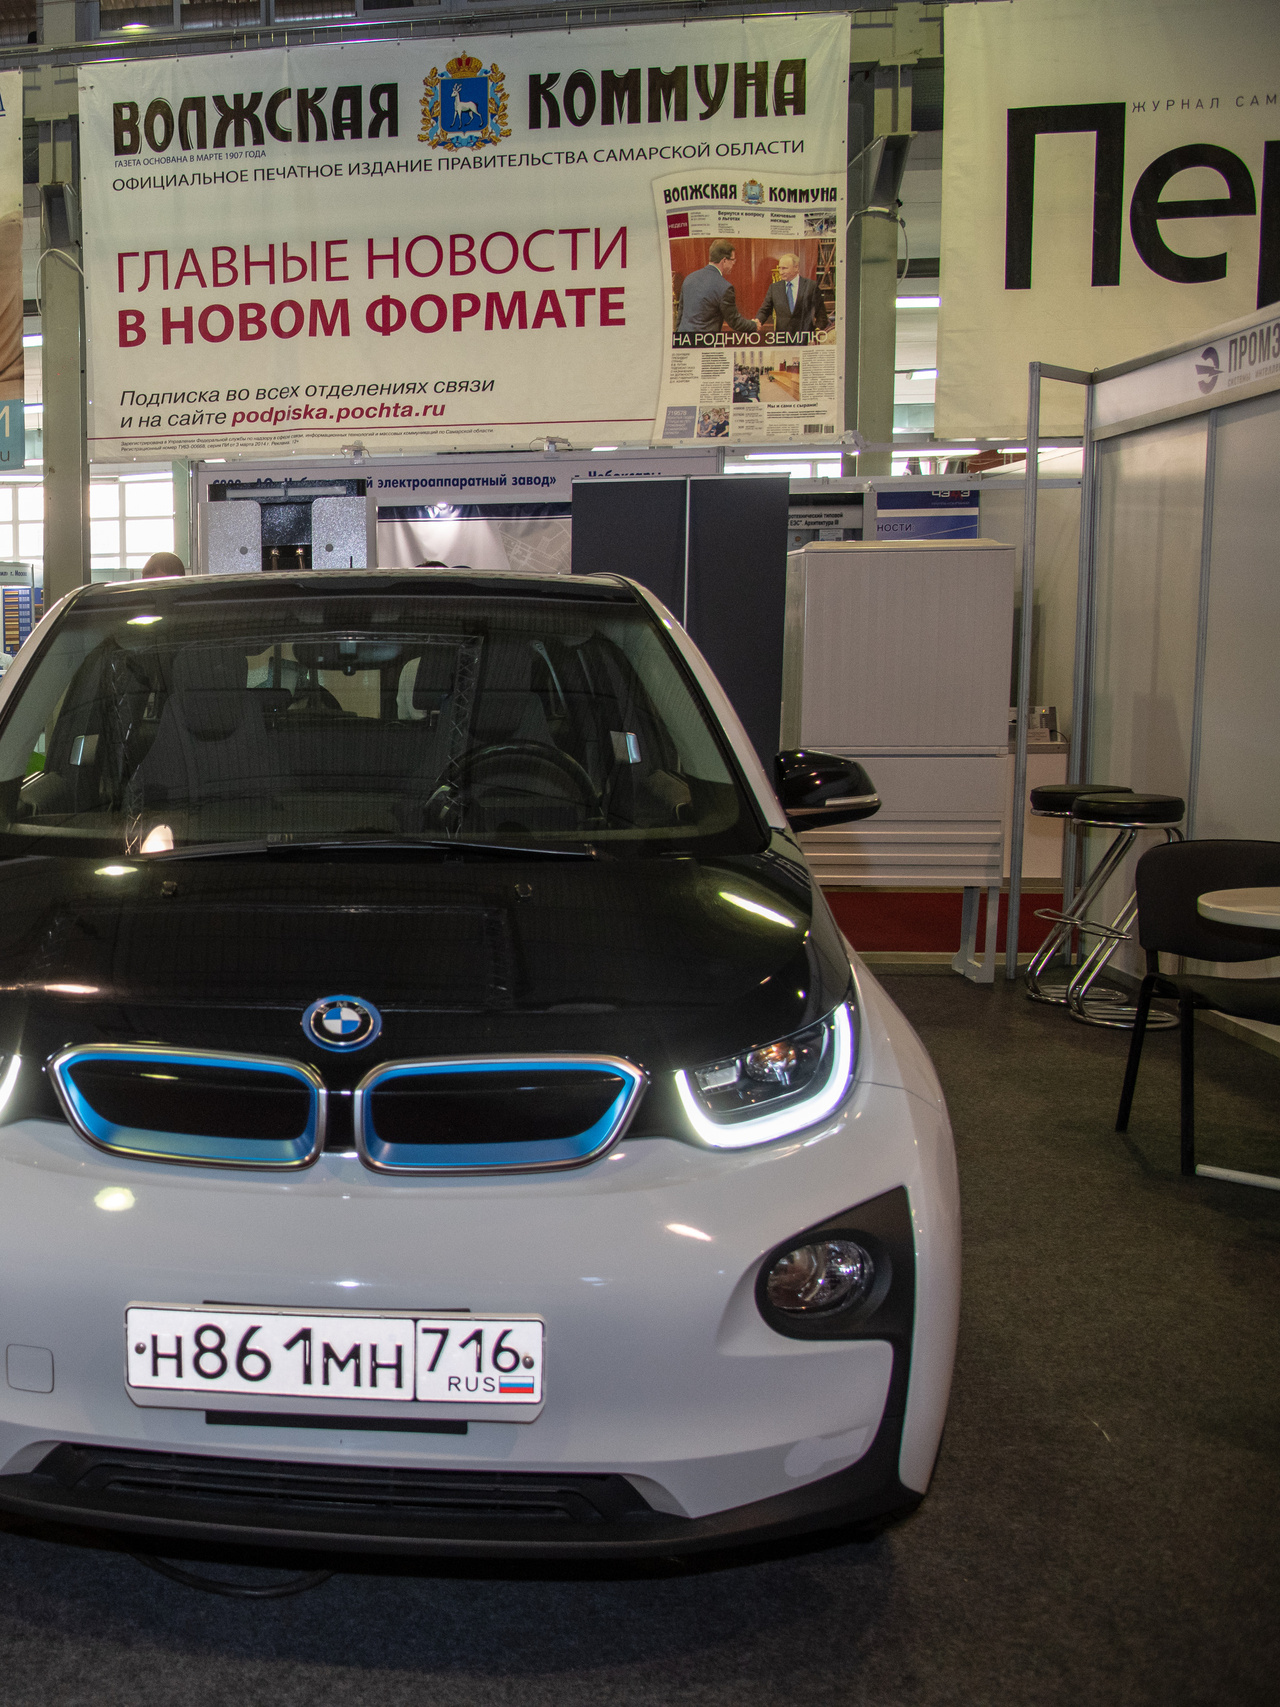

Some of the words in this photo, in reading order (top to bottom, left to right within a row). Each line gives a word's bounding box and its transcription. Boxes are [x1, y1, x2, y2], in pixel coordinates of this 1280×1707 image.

[113, 82, 399, 156] ВОЛЖСКАЯ
[528, 58, 807, 130] КОММУНА
[1132, 97, 1220, 113] ЖУРНАЛ
[1235, 93, 1277, 107] САМ
[112, 169, 249, 192] ОФИЦИАЛЬНОЕ
[253, 163, 343, 182] ПЕЧАТНОЕ
[349, 158, 432, 177] ИЗДАНИЕ
[437, 150, 588, 171] ПРАВИТЕЛЬСТВА
[594, 141, 710, 162] САМАРСКОЙ
[715, 139, 805, 158] ОБЛАСТИ
[114, 158, 142, 168] ГАЗЕТА
[143, 154, 188, 166] ОСНОВАНА
[189, 154, 195, 163] В
[196, 152, 223, 162] МАРТЕ
[225, 151, 243, 160] 1907
[245, 149, 267, 160] ГОДА
[663, 183, 737, 204] ВОЛЖСКАЯ
[769, 186, 837, 204] КОММУНА
[1005, 101, 1280, 310] Пе
[118, 239, 349, 293] ГЛАВНЫЕ
[368, 226, 628, 280] НОВОСТИ
[119, 310, 146, 348] В
[162, 298, 350, 345] НОВОМ
[366, 286, 626, 337] ФОРМАТЕ
[672, 333, 691, 346] НА
[695, 332, 760, 347] РОДНУЮ
[765, 330, 828, 345] ЗЕМЛЮ
[120, 389, 220, 407] Подписка
[226, 388, 249, 401] во
[255, 385, 300, 400] всех
[305, 382, 428, 399] отделениях
[433, 379, 495, 394] связи
[120, 416, 133, 428] и
[138, 415, 161, 428] на
[167, 410, 227, 426] сайте
[231, 402, 445, 427] podpiska.pochta.ru
[377, 473, 507, 491] электроаппаратный
[511, 474, 556, 487] завод»
[422, 1328, 520, 1373] 716
[447, 1376, 496, 1393] RUS
